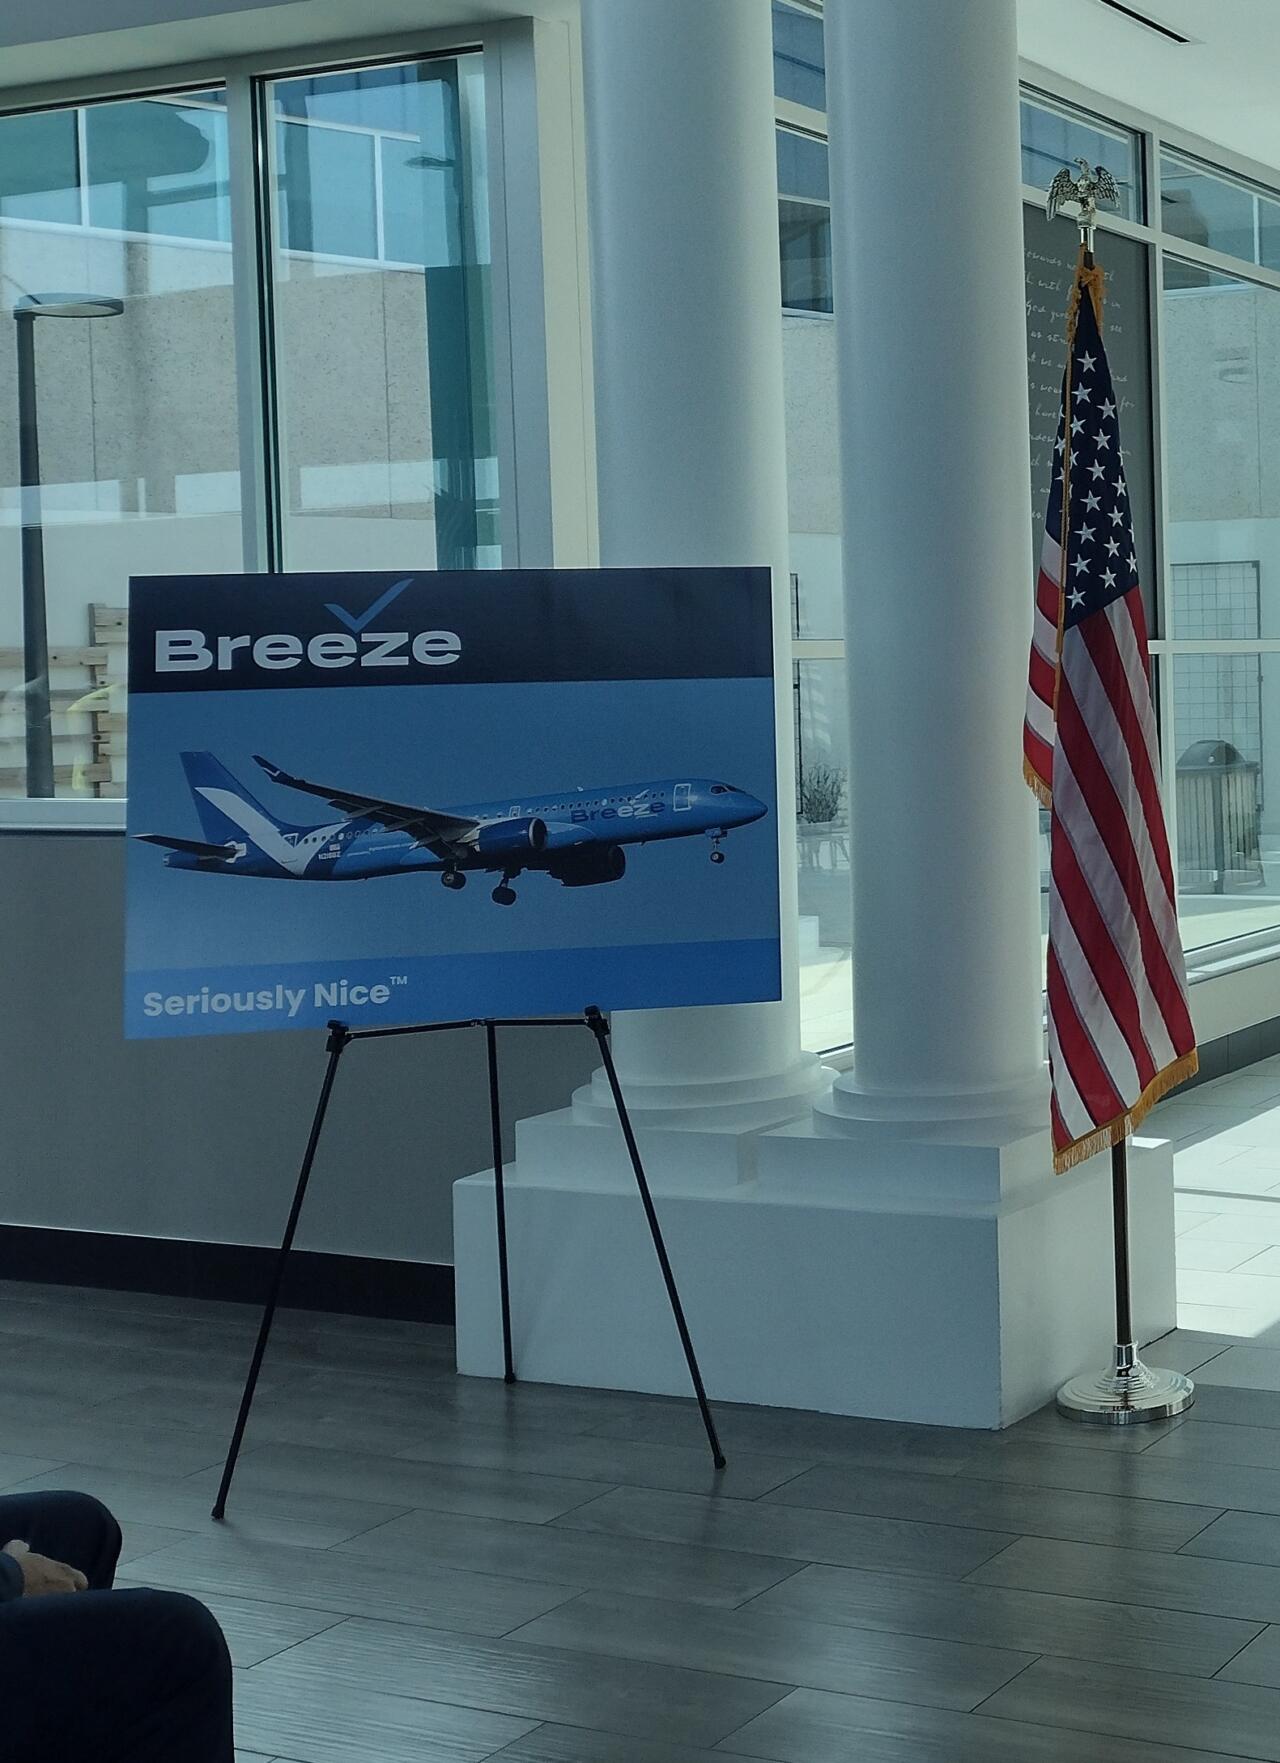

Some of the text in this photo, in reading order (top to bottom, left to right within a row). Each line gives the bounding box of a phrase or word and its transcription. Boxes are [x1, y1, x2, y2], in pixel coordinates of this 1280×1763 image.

[154, 628, 463, 672] Breeze
[570, 802, 666, 823] Breeze
[143, 983, 304, 1018] Seriously
